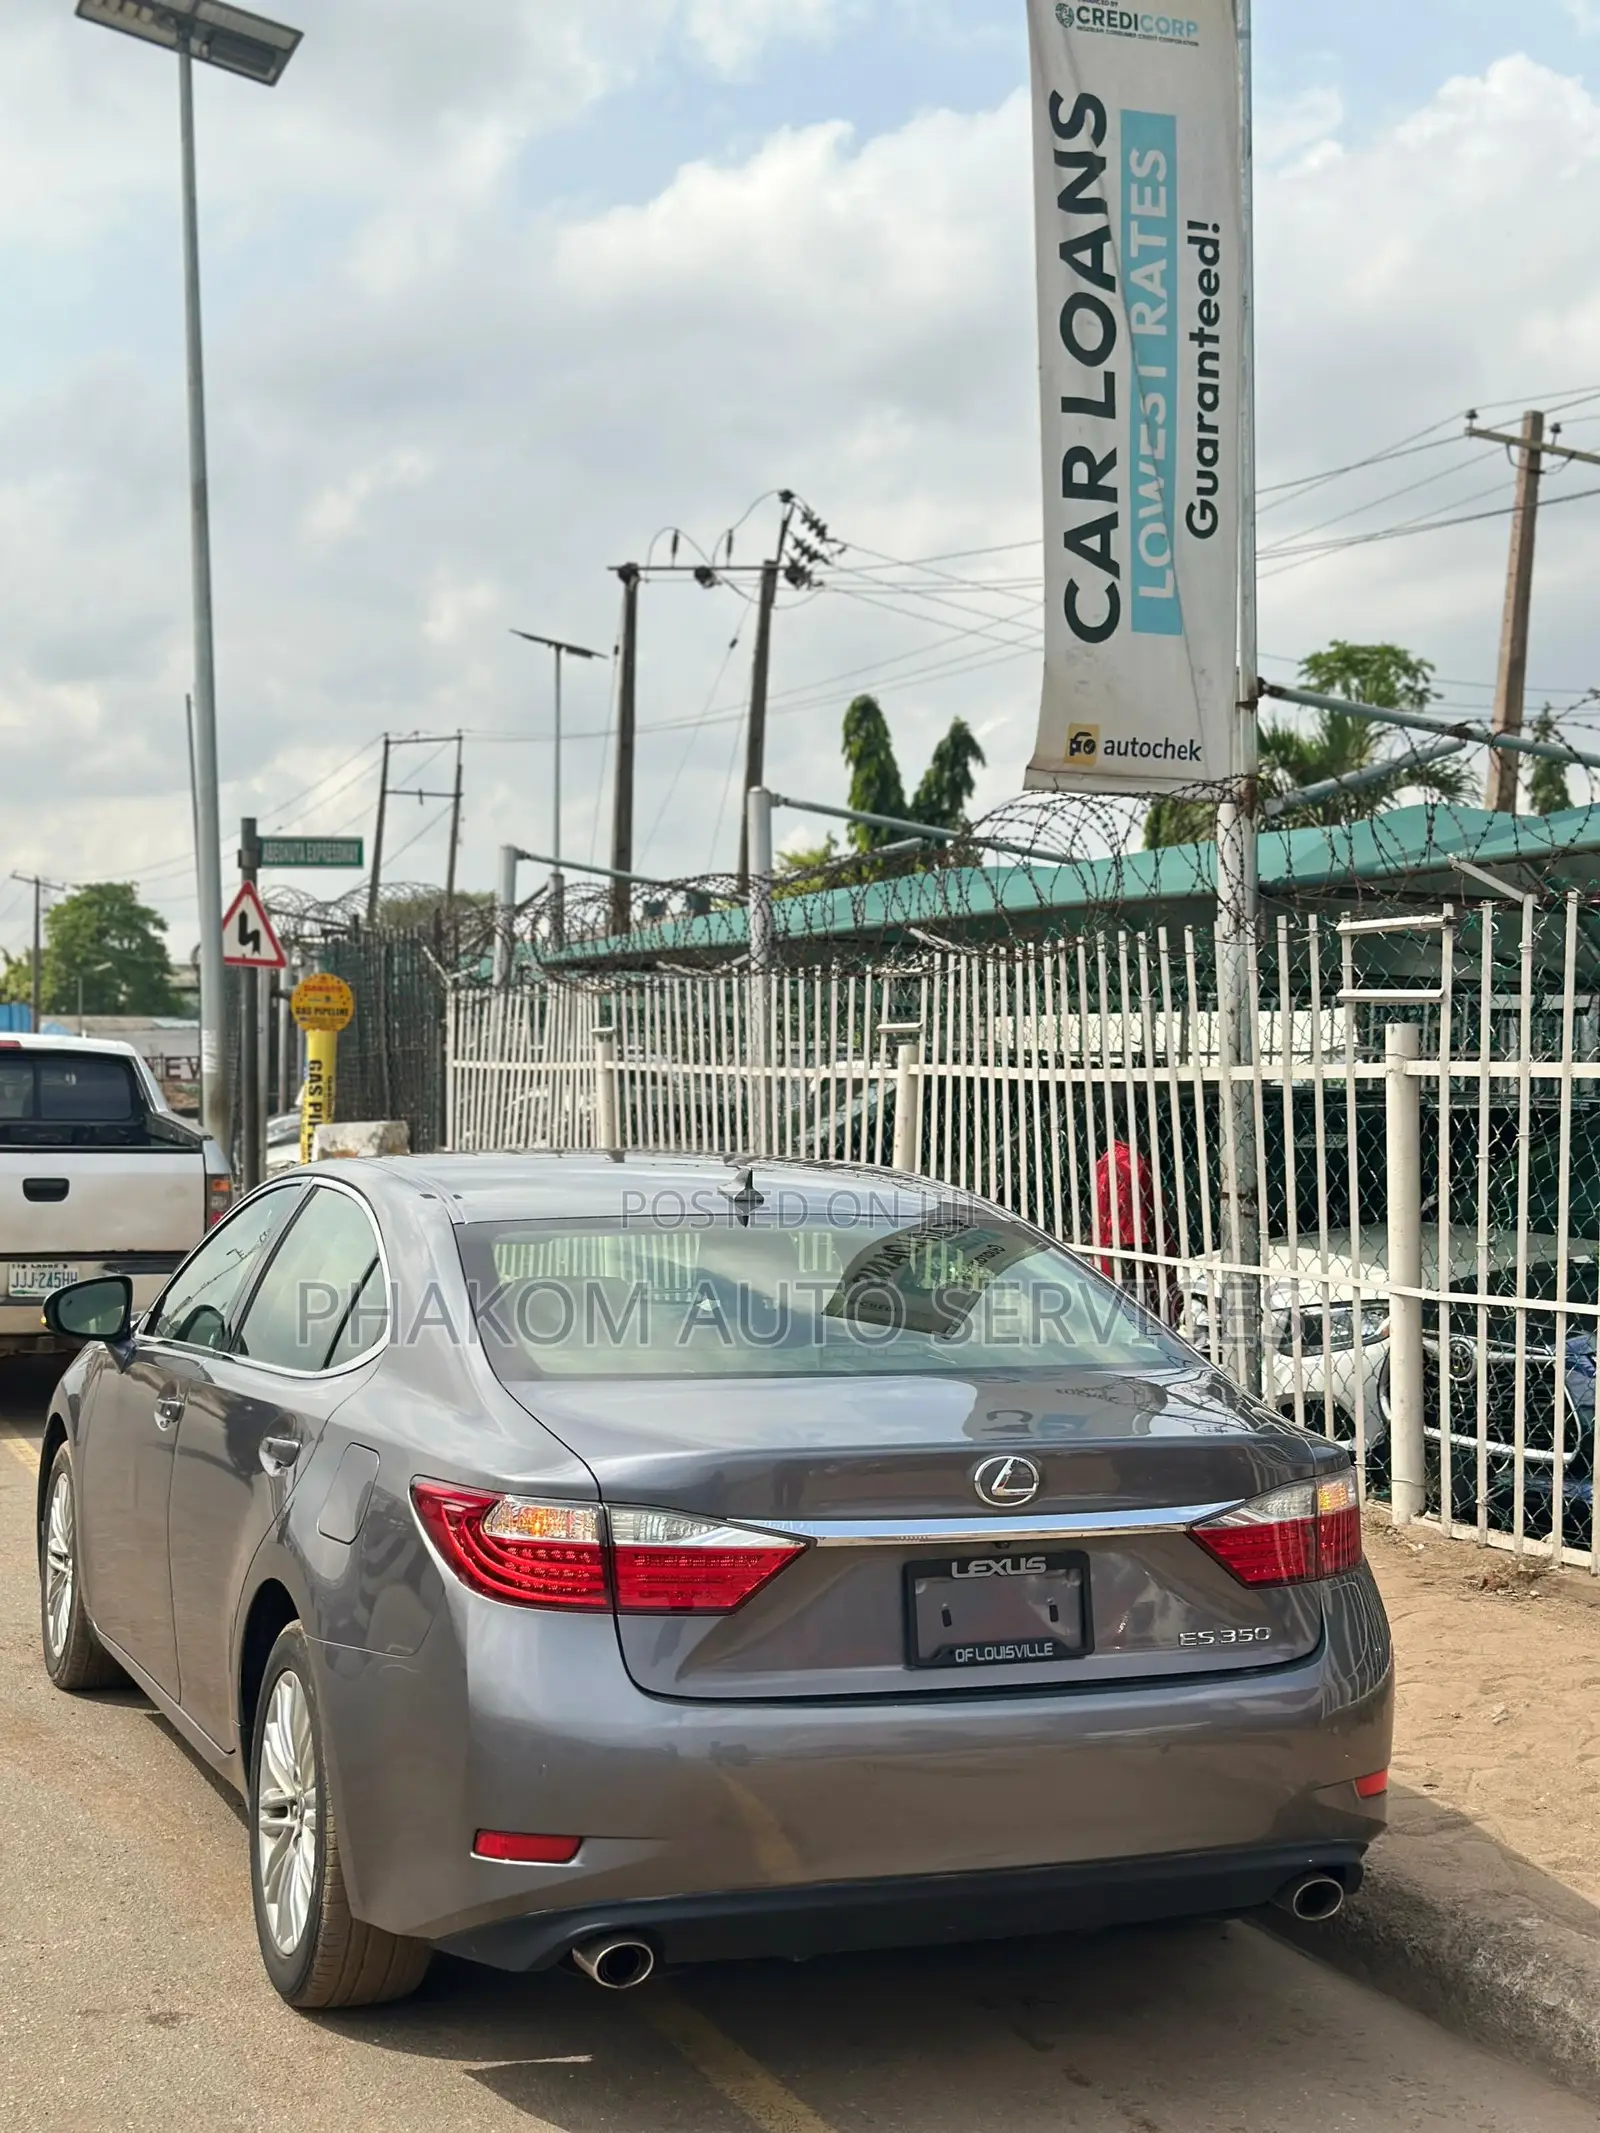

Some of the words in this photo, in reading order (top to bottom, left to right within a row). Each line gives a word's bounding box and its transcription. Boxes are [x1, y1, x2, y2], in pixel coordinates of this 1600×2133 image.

[1076, 5, 1199, 39] CREDICORP
[1049, 89, 1117, 420] LOANS
[1129, 147, 1168, 337] RATES
[1185, 219, 1221, 540] Guaranteed!
[1063, 446, 1121, 644] CAR
[1103, 737, 1202, 762] autochek
[308, 1060, 322, 1096] GAS
[951, 1556, 1047, 1579] LEXUS
[955, 1648, 974, 1662] OF
[975, 1642, 1054, 1661] LOUISVILLE
[1179, 1630, 1215, 1646] ES
[1219, 1626, 1272, 1643] 350
